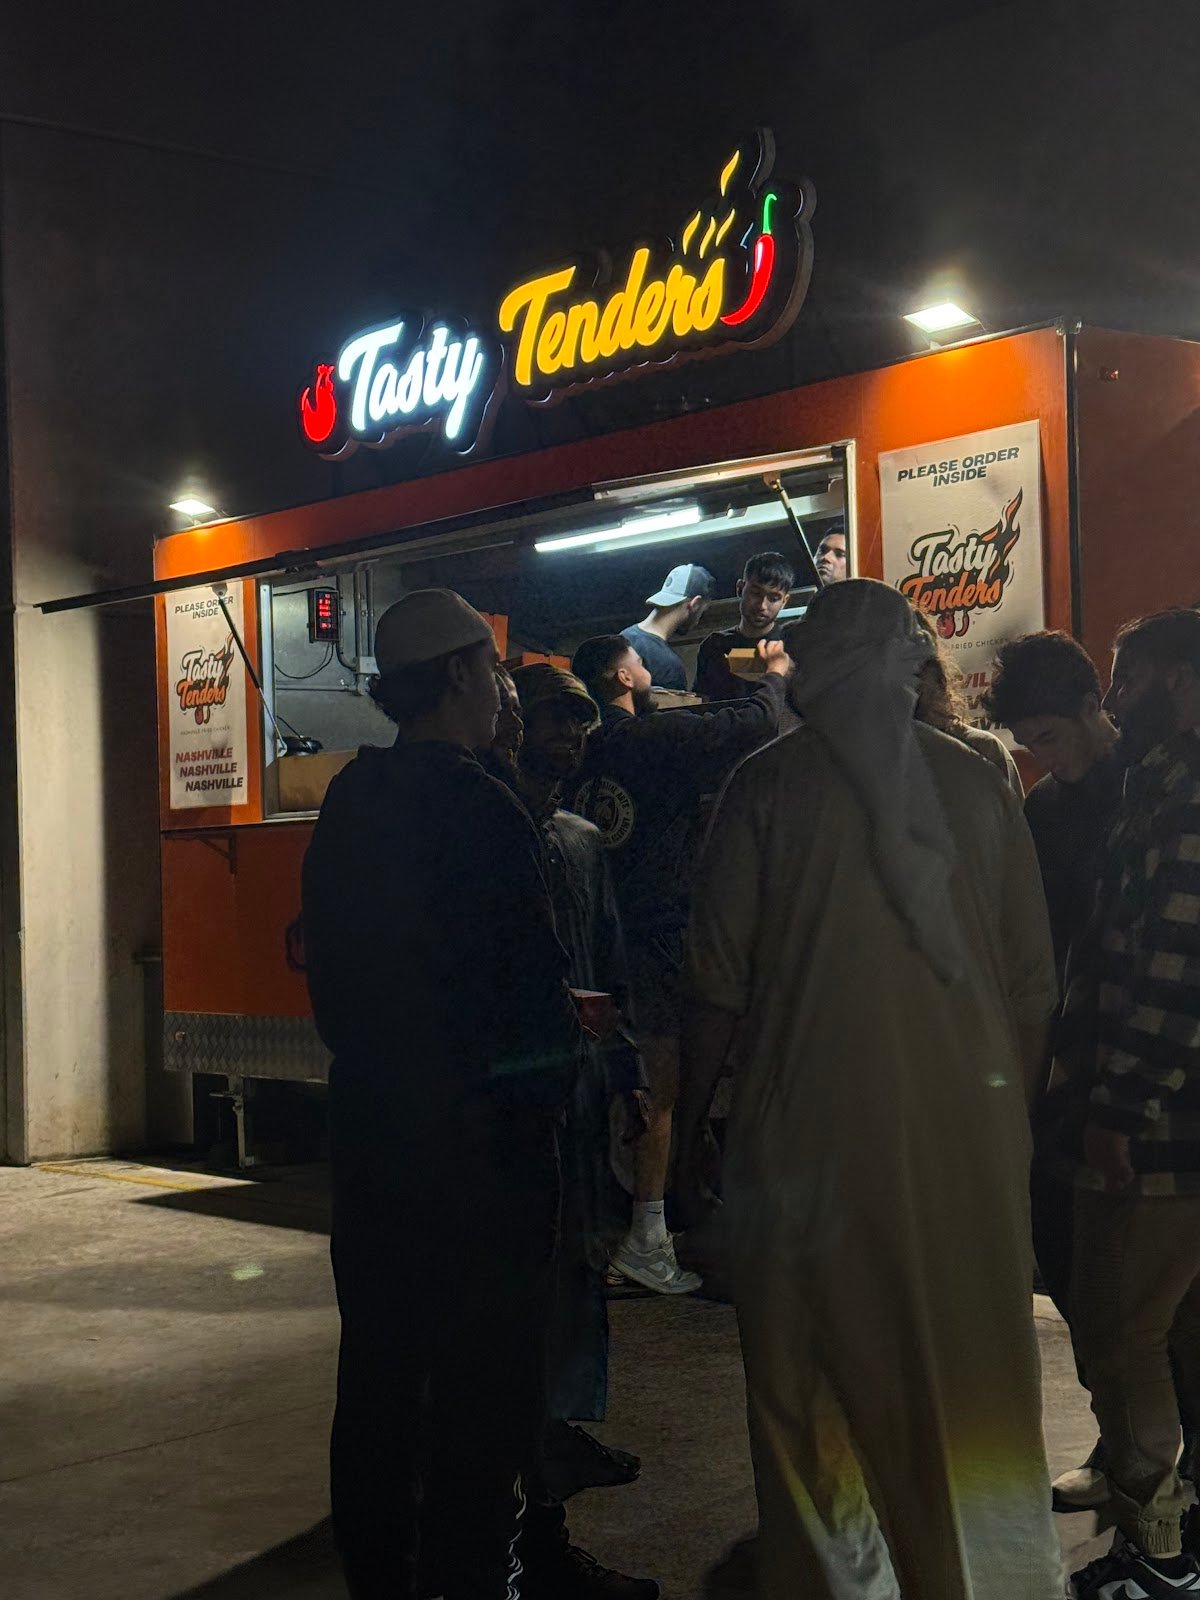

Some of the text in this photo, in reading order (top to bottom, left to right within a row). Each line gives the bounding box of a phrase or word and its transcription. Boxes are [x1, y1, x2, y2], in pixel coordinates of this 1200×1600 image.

[340, 248, 725, 439] Tasty Tenders
[897, 447, 1019, 482] PLEASE ORDER
[933, 466, 986, 487] INSIDE
[911, 530, 999, 583] Tasty
[902, 572, 1002, 610] Tenders
[174, 601, 205, 614] PLEASE
[192, 607, 219, 619] INSIDE
[951, 642, 973, 650] FRIED
[182, 652, 223, 687] Tasty
[178, 678, 226, 706] Tenders
[175, 748, 232, 763] NASHVILLE
[180, 763, 237, 778] NASHVILLE
[185, 777, 244, 792] NASHVILLE
